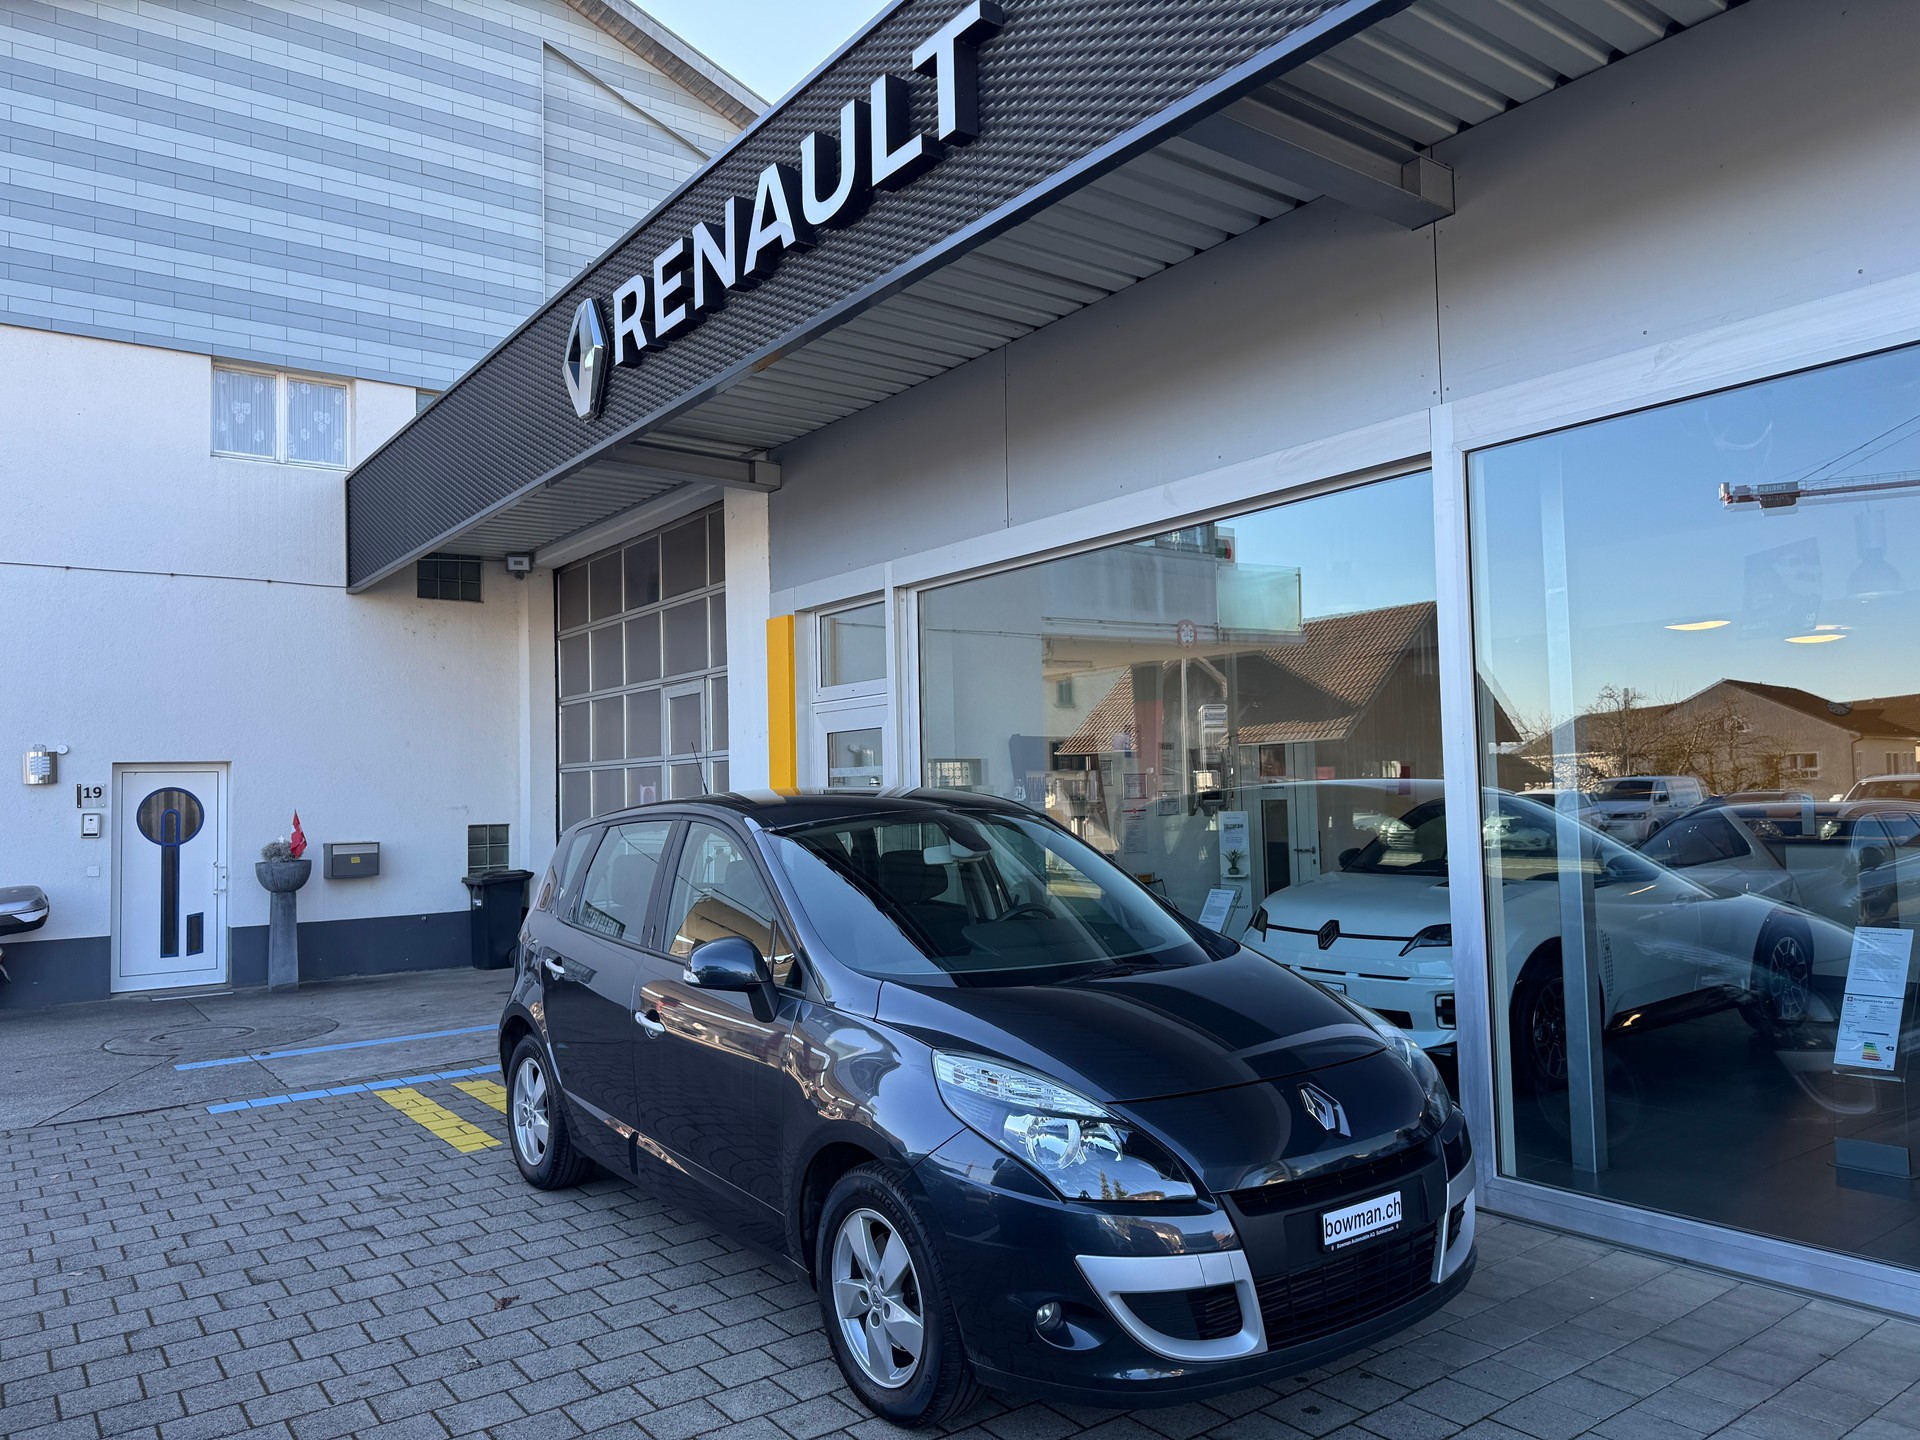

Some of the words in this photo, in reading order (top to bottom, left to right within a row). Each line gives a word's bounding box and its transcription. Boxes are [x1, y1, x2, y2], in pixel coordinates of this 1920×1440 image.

[613, 0, 983, 367] RENAULT
[83, 786, 102, 799] 19
[873, 1188, 917, 1245] MICHELIN
[1325, 1196, 1401, 1239] bowman.ch
